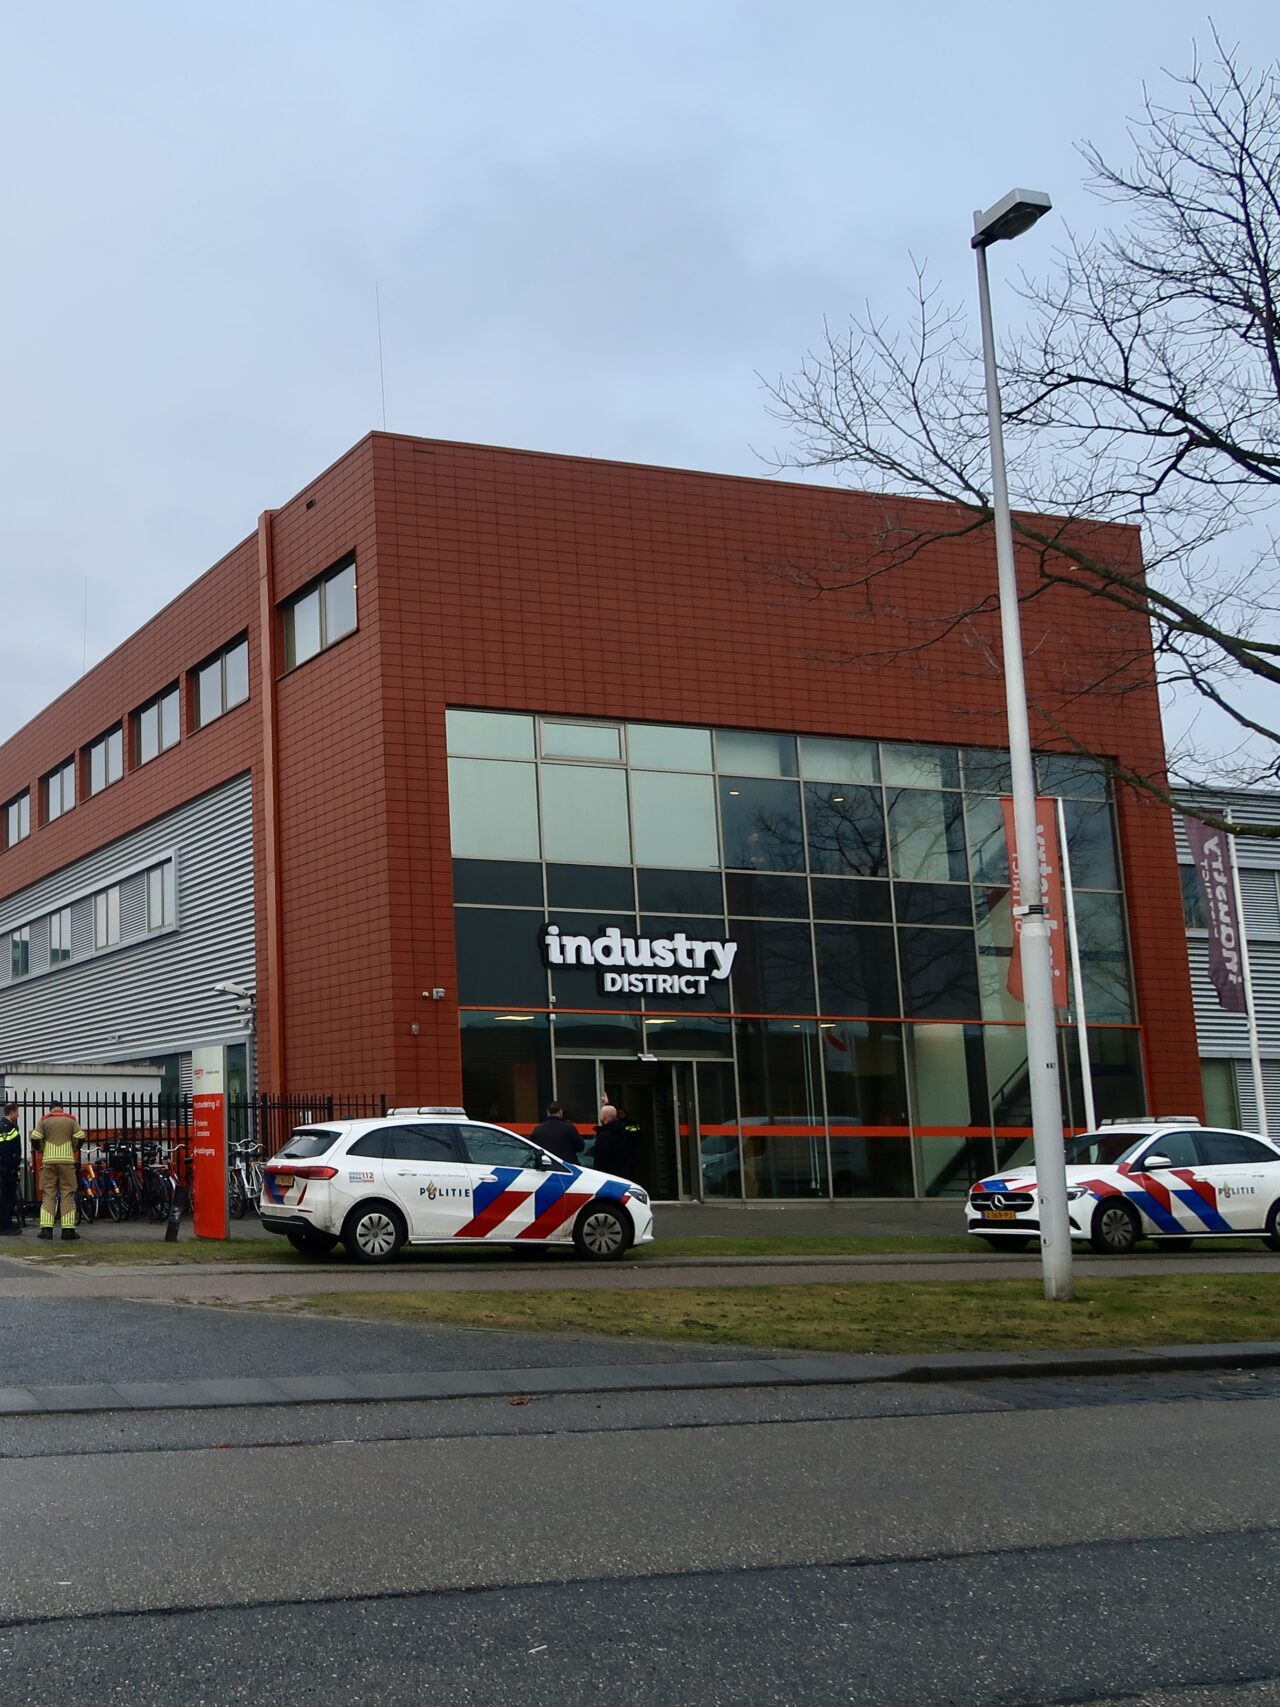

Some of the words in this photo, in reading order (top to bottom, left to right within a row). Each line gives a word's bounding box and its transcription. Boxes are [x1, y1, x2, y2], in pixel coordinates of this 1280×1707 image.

[545, 925, 738, 980] industry
[603, 972, 709, 995] DISTRICT
[420, 1187, 470, 1201] POLITIE
[1218, 1186, 1255, 1199] POLITIE
